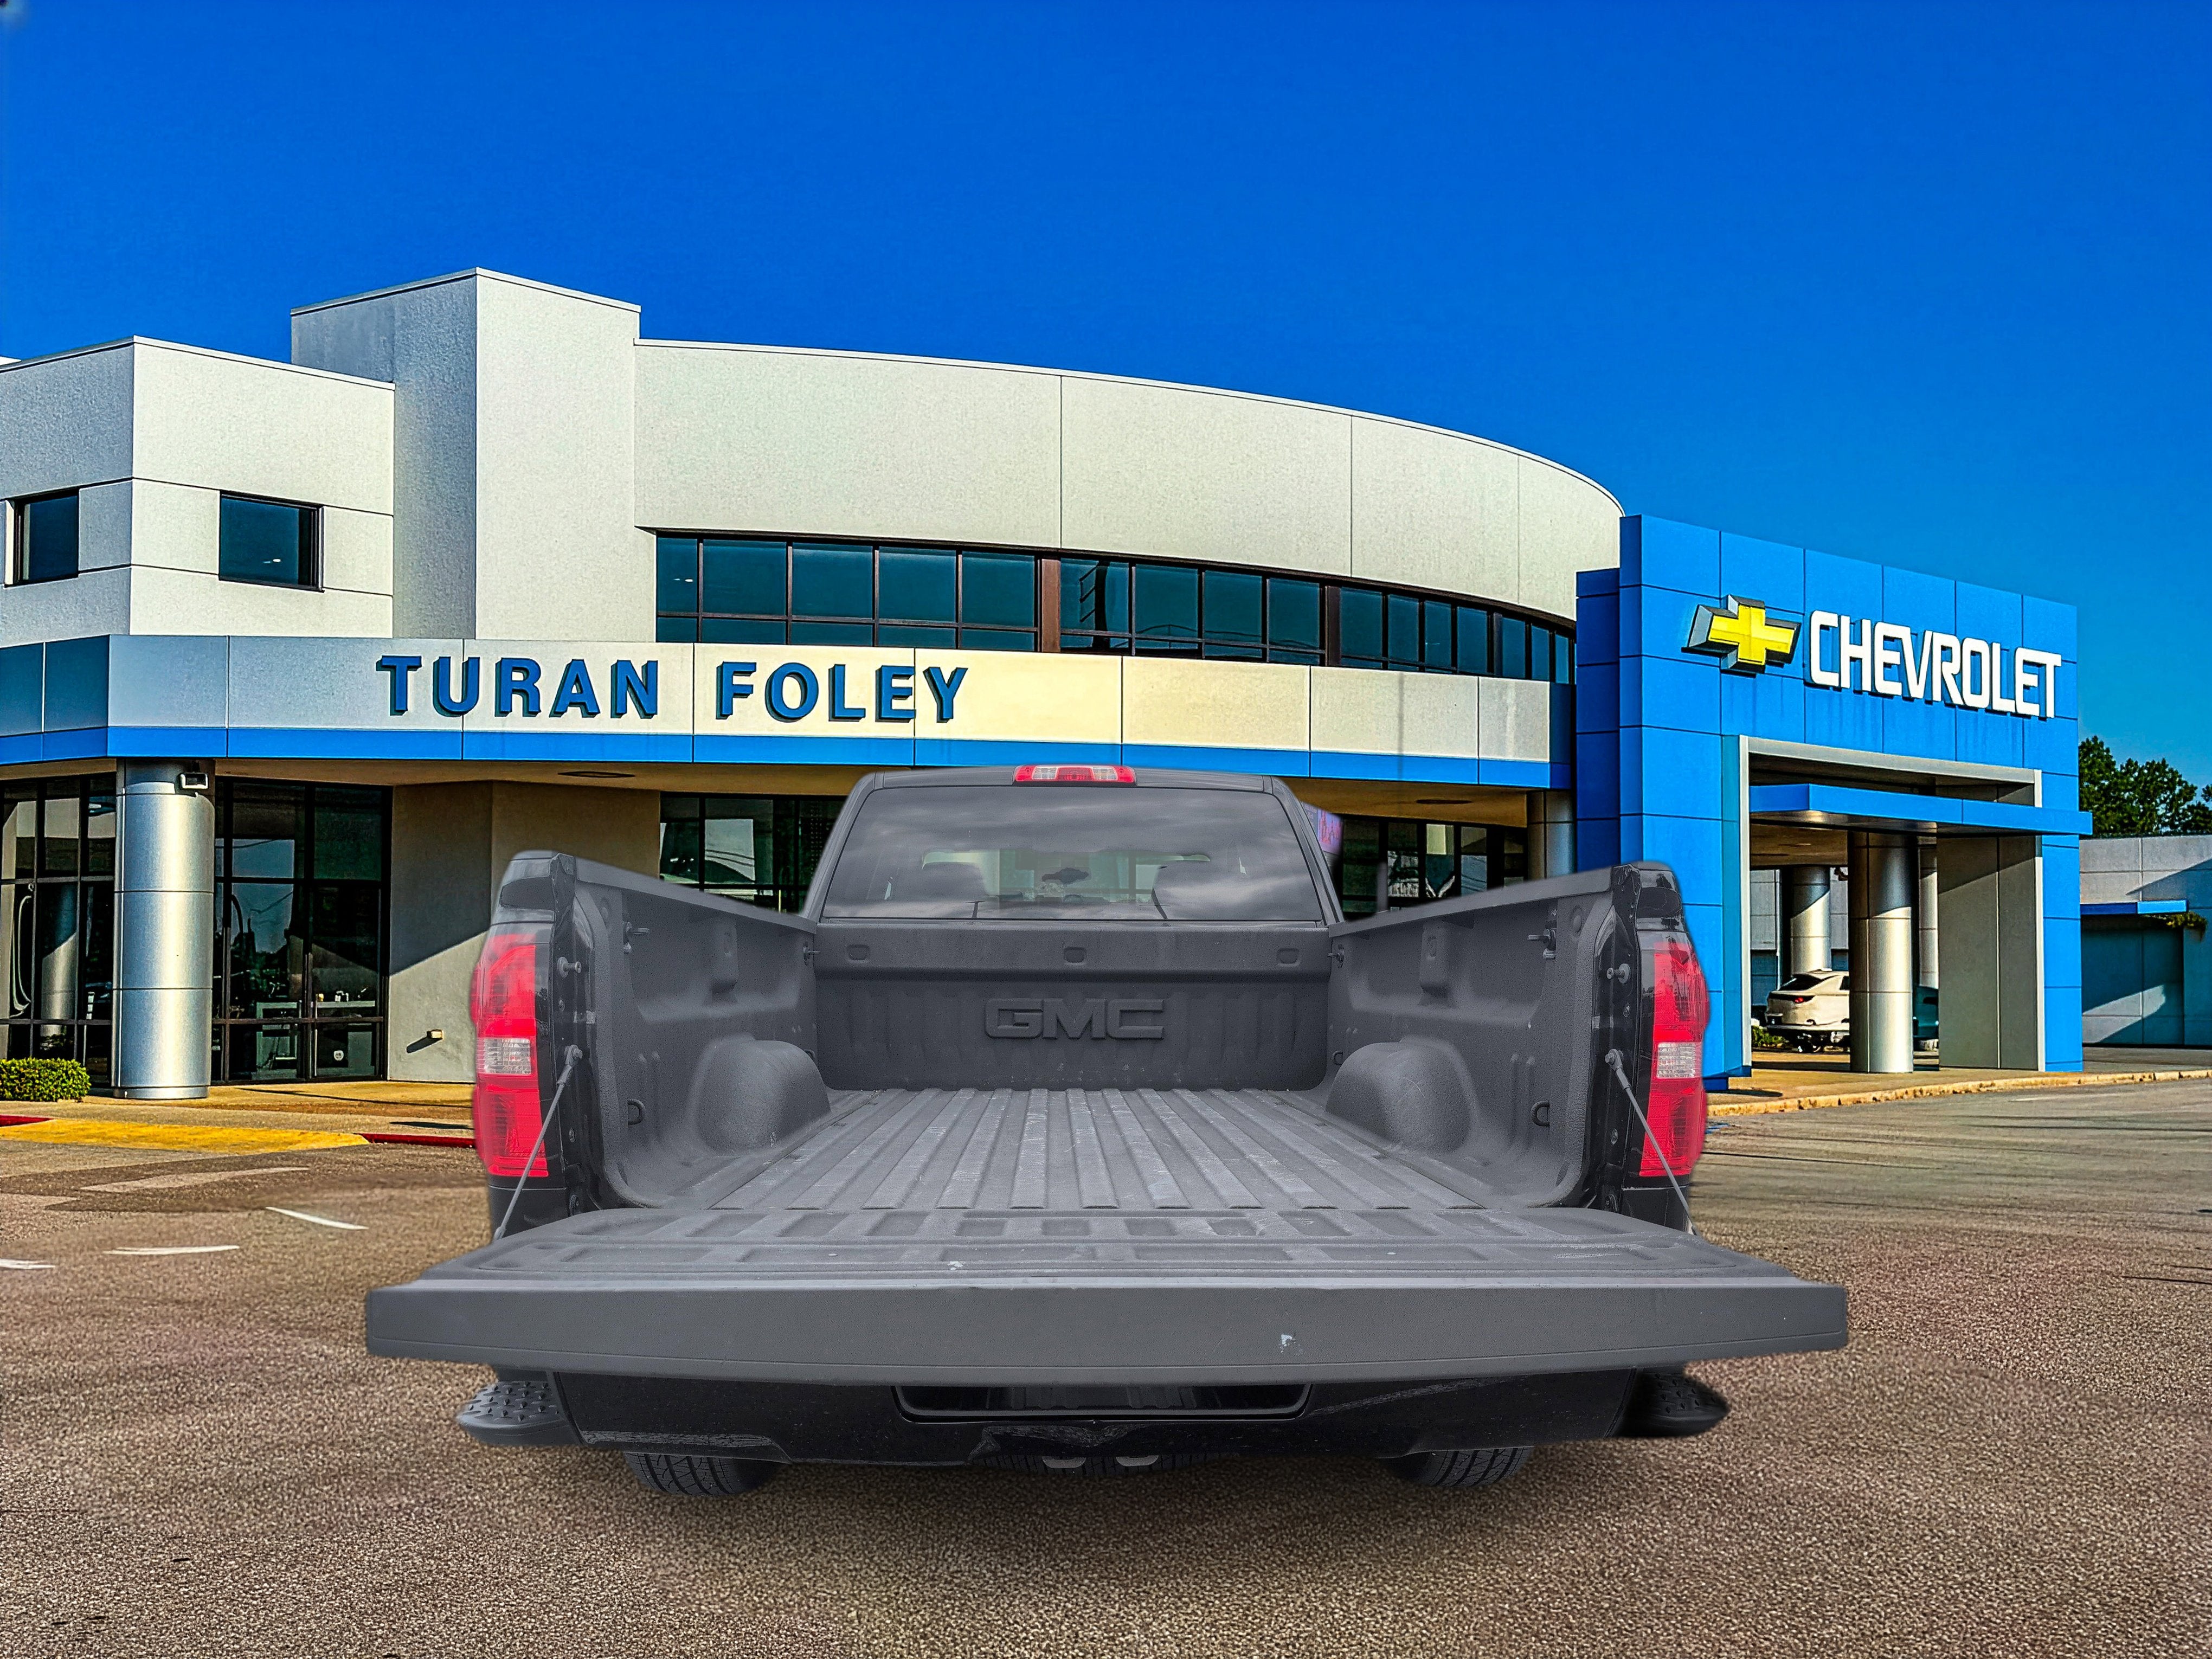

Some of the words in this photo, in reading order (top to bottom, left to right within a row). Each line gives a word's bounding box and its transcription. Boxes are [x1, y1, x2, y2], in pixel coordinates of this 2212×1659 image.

[376, 655, 658, 719] TURAN
[716, 661, 969, 723] FOLEY
[1809, 610, 2062, 718] CHEVROLET
[985, 998, 1165, 1040] GMC
